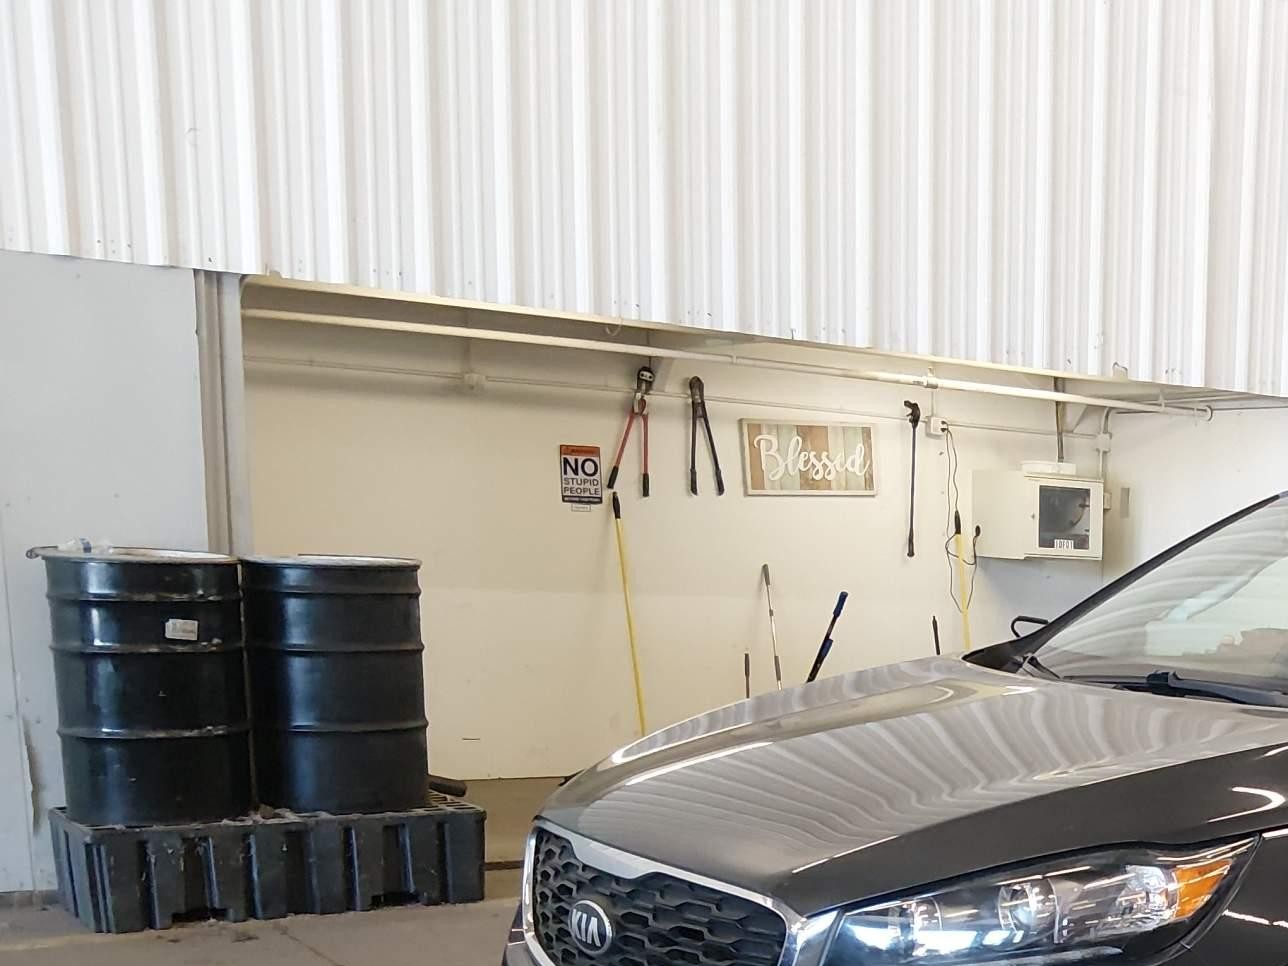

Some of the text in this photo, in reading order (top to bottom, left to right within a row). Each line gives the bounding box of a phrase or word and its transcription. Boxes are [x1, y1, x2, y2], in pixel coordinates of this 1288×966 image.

[563, 456, 599, 477] NO
[753, 434, 870, 481] Blessed
[563, 478, 599, 487] STUPID
[563, 486, 600, 496] PEOPLE
[572, 908, 601, 948] KIA
